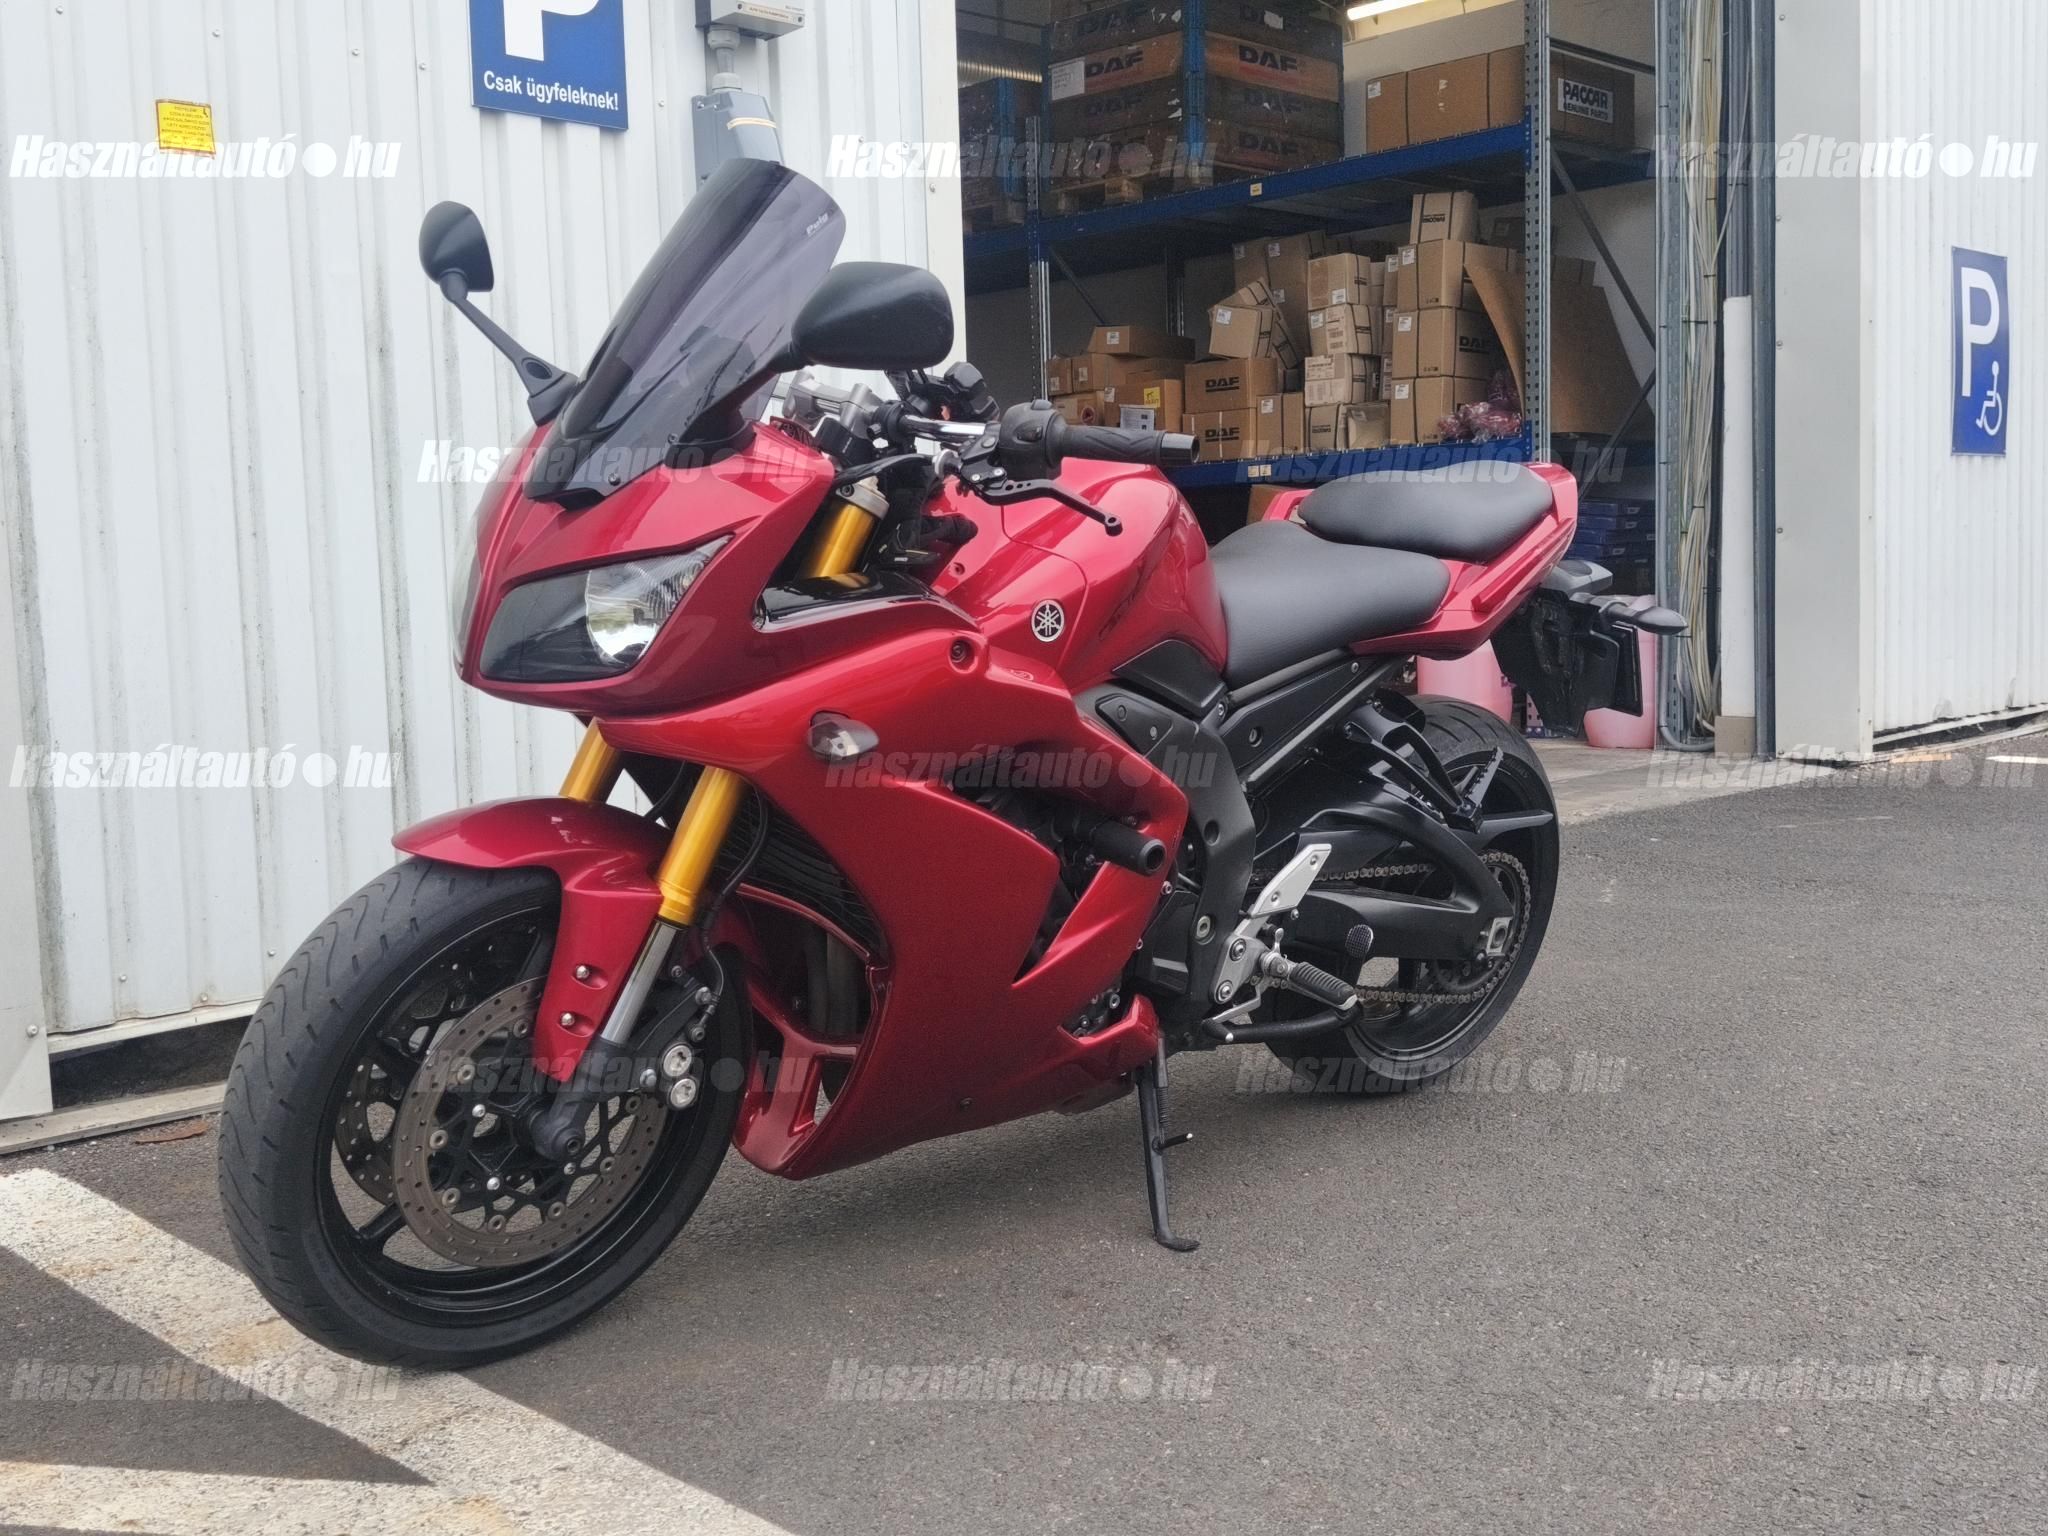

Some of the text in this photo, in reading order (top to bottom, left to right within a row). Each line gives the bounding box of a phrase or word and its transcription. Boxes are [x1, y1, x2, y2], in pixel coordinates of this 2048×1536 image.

[1085, 50, 1143, 77] DAF
[1239, 45, 1298, 71] DAF
[483, 70, 618, 110] Csak ügyfeleknek!
[1563, 81, 1608, 109] PACCAR
[1239, 131, 1298, 155] DAF
[1961, 266, 2000, 397] P
[1205, 376, 1240, 388] DAF
[1205, 427, 1240, 438] DAF
